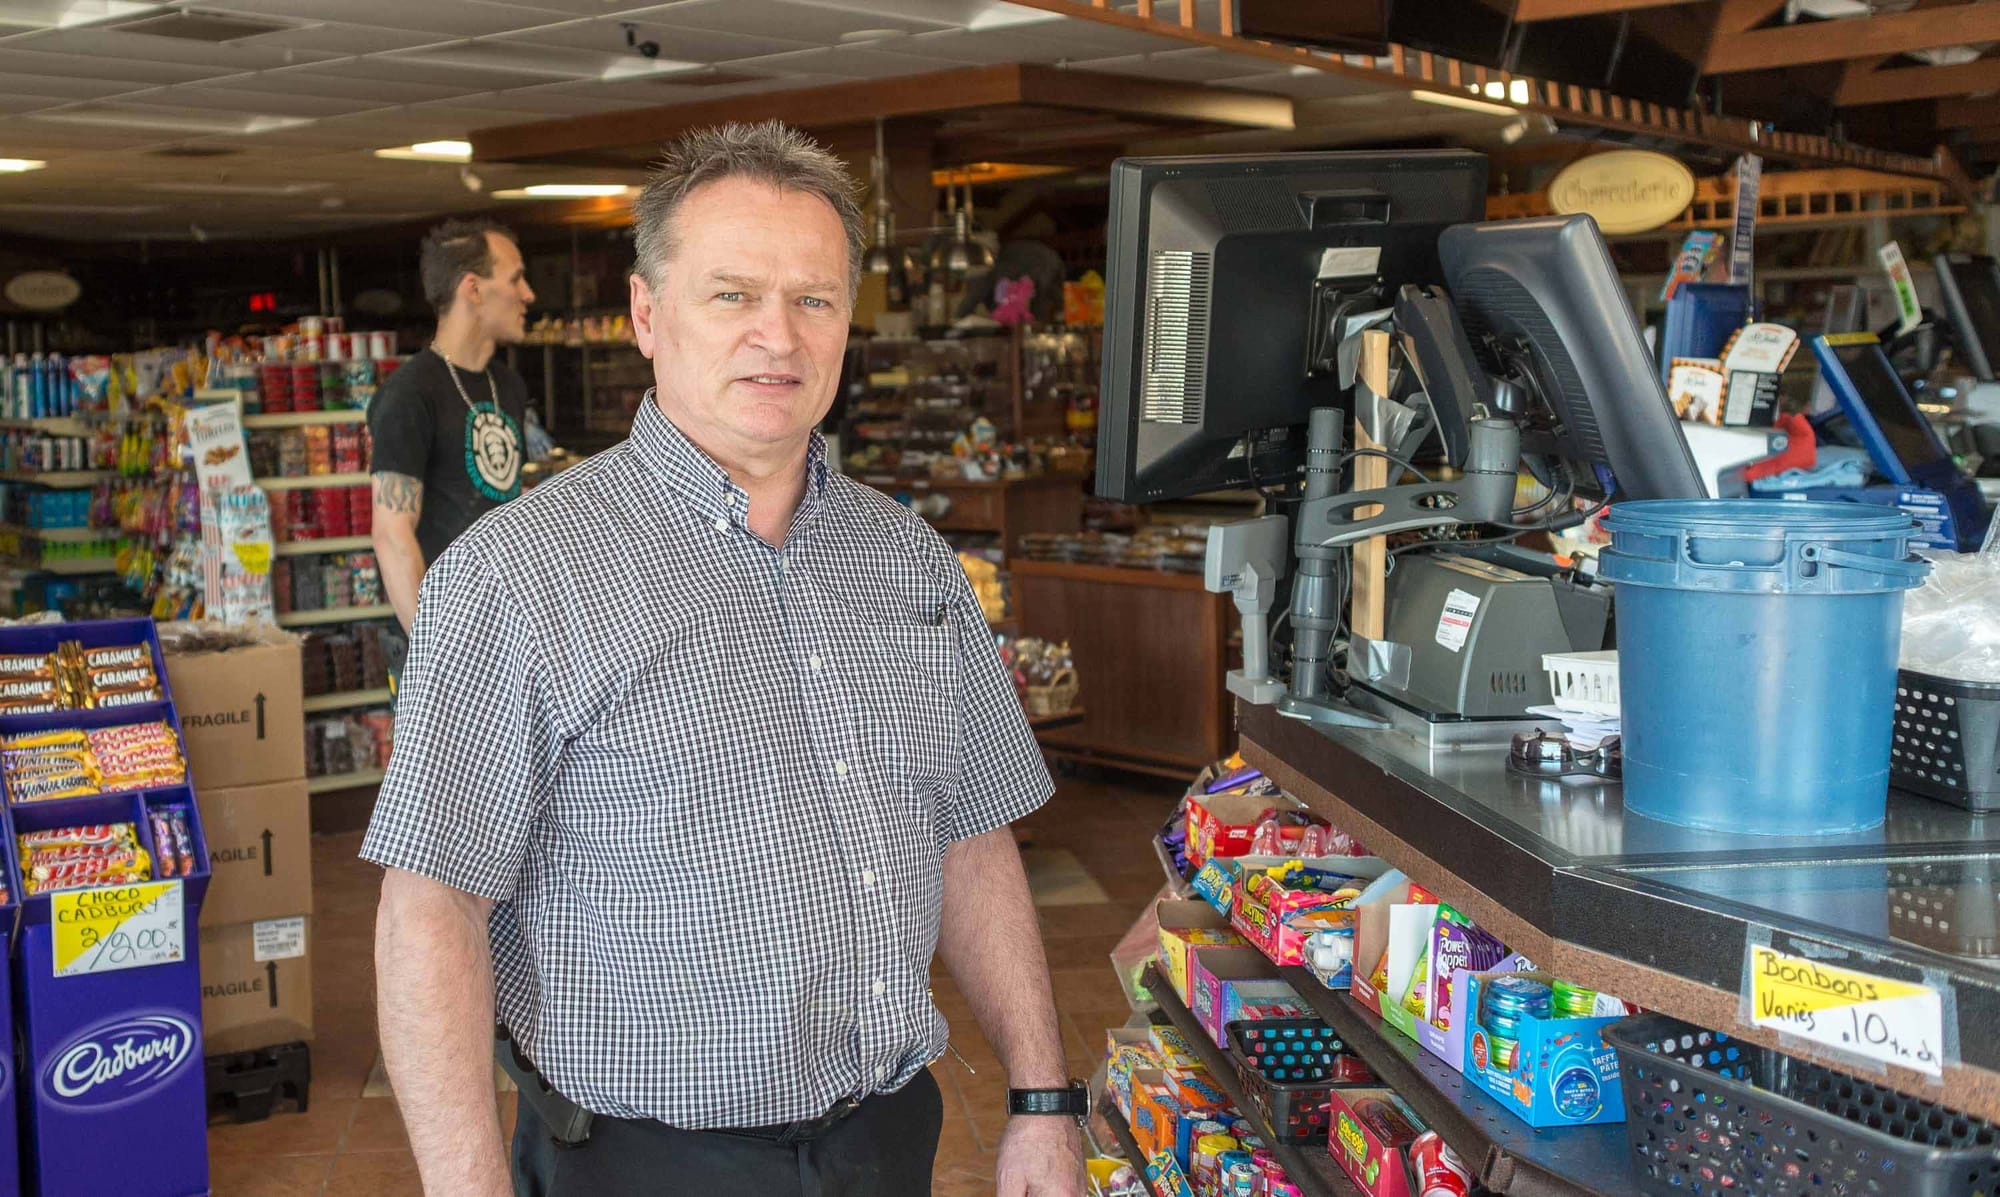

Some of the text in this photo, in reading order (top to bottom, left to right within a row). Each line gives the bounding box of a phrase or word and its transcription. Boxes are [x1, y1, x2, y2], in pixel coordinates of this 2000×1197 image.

[87, 649, 142, 667] CARAMILK
[93, 668, 149, 687] CARAMILK
[99, 689, 154, 708] CARAMILK
[180, 711, 250, 729] FRAGILE
[77, 887, 140, 908] CHOCO
[58, 897, 158, 923] CADBURY
[1439, 937, 1467, 954] Power
[1760, 951, 1880, 1001] Bonbons
[1842, 1007, 1889, 1045] .10
[53, 1032, 178, 1098] Cadbury
[1591, 1051, 1615, 1067] TAFFY
